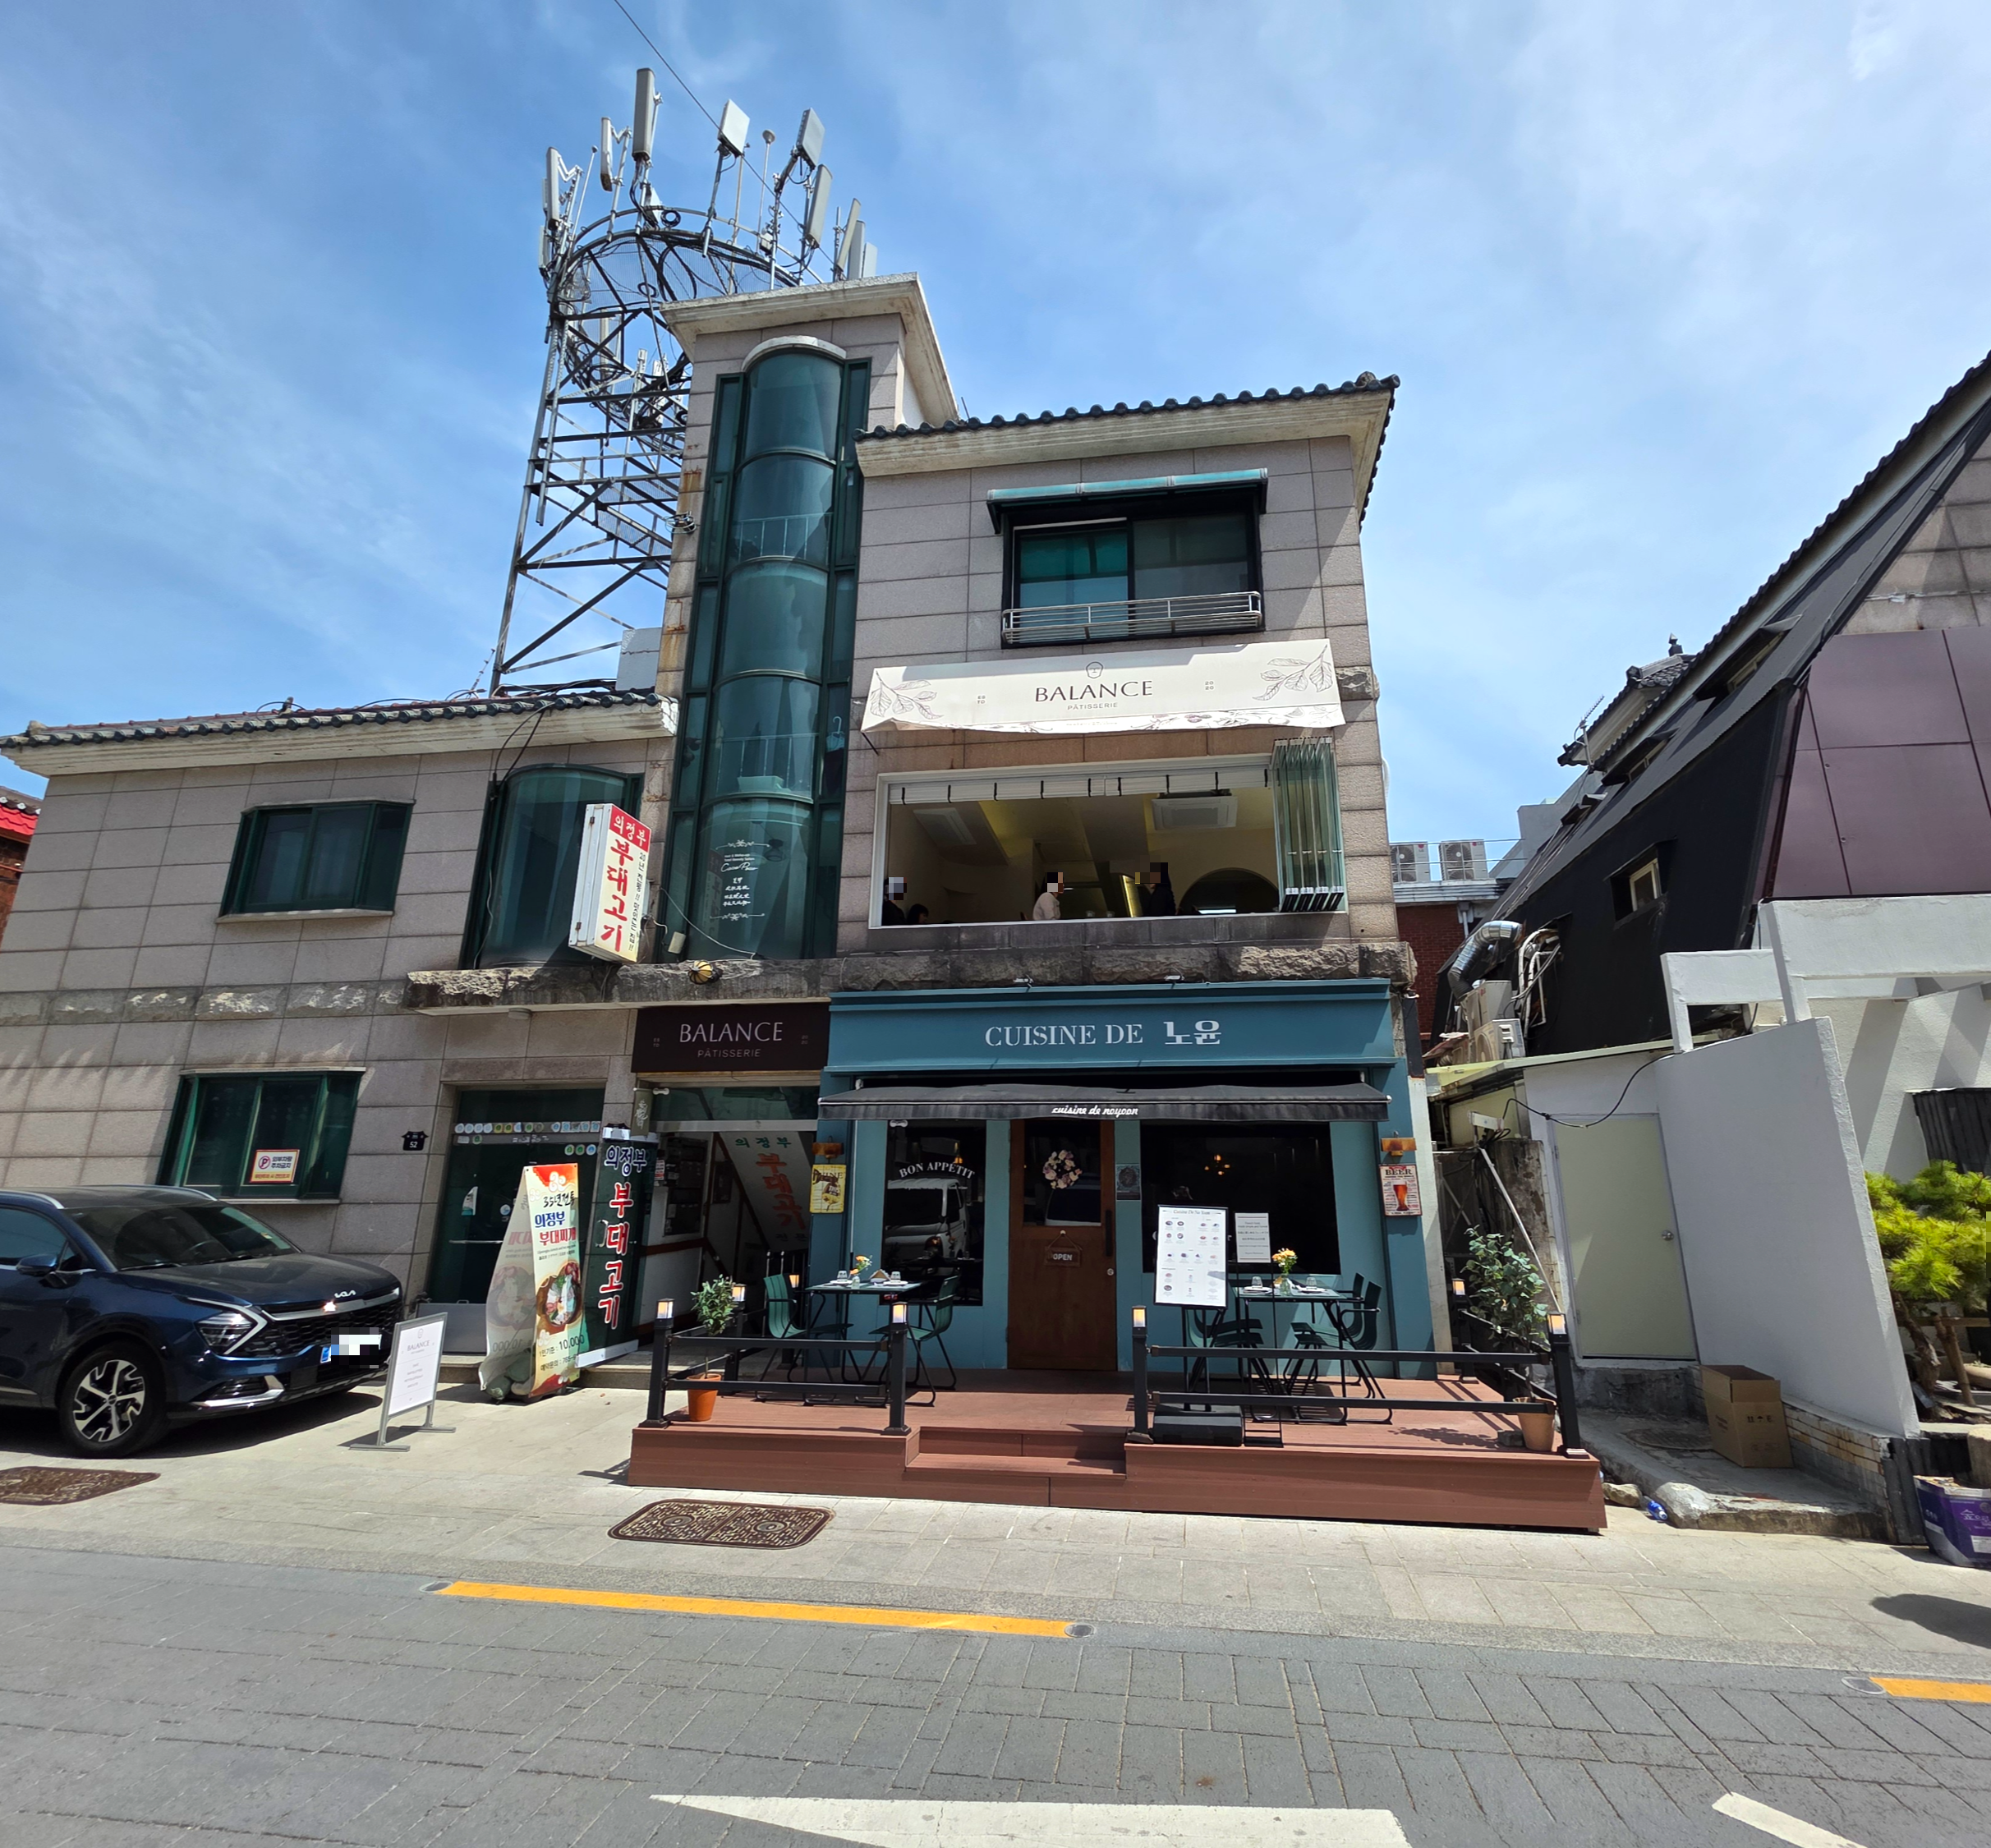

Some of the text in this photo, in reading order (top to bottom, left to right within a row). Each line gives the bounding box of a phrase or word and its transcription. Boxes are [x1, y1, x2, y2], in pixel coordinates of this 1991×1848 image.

[1035, 680, 1153, 702] BALANCE
[614, 815, 646, 848] 의정부
[600, 839, 634, 952] 부대고기
[679, 1022, 784, 1043] BALANCE
[985, 1020, 1221, 1046] CUISINE DE 노윤
[1051, 1105, 1138, 1118] cuisine de noyoon
[735, 1137, 792, 1149] 의정부
[604, 1145, 647, 1176] 의정부
[899, 1161, 976, 1179] BON APPETIT
[756, 1152, 807, 1230] 부대고기
[535, 1211, 566, 1228] 의정부
[540, 1227, 577, 1246] 부대찌개
[598, 1181, 633, 1331] 부대고기
[407, 1340, 430, 1352] BALANCE
[559, 1335, 585, 1349] 10,000
